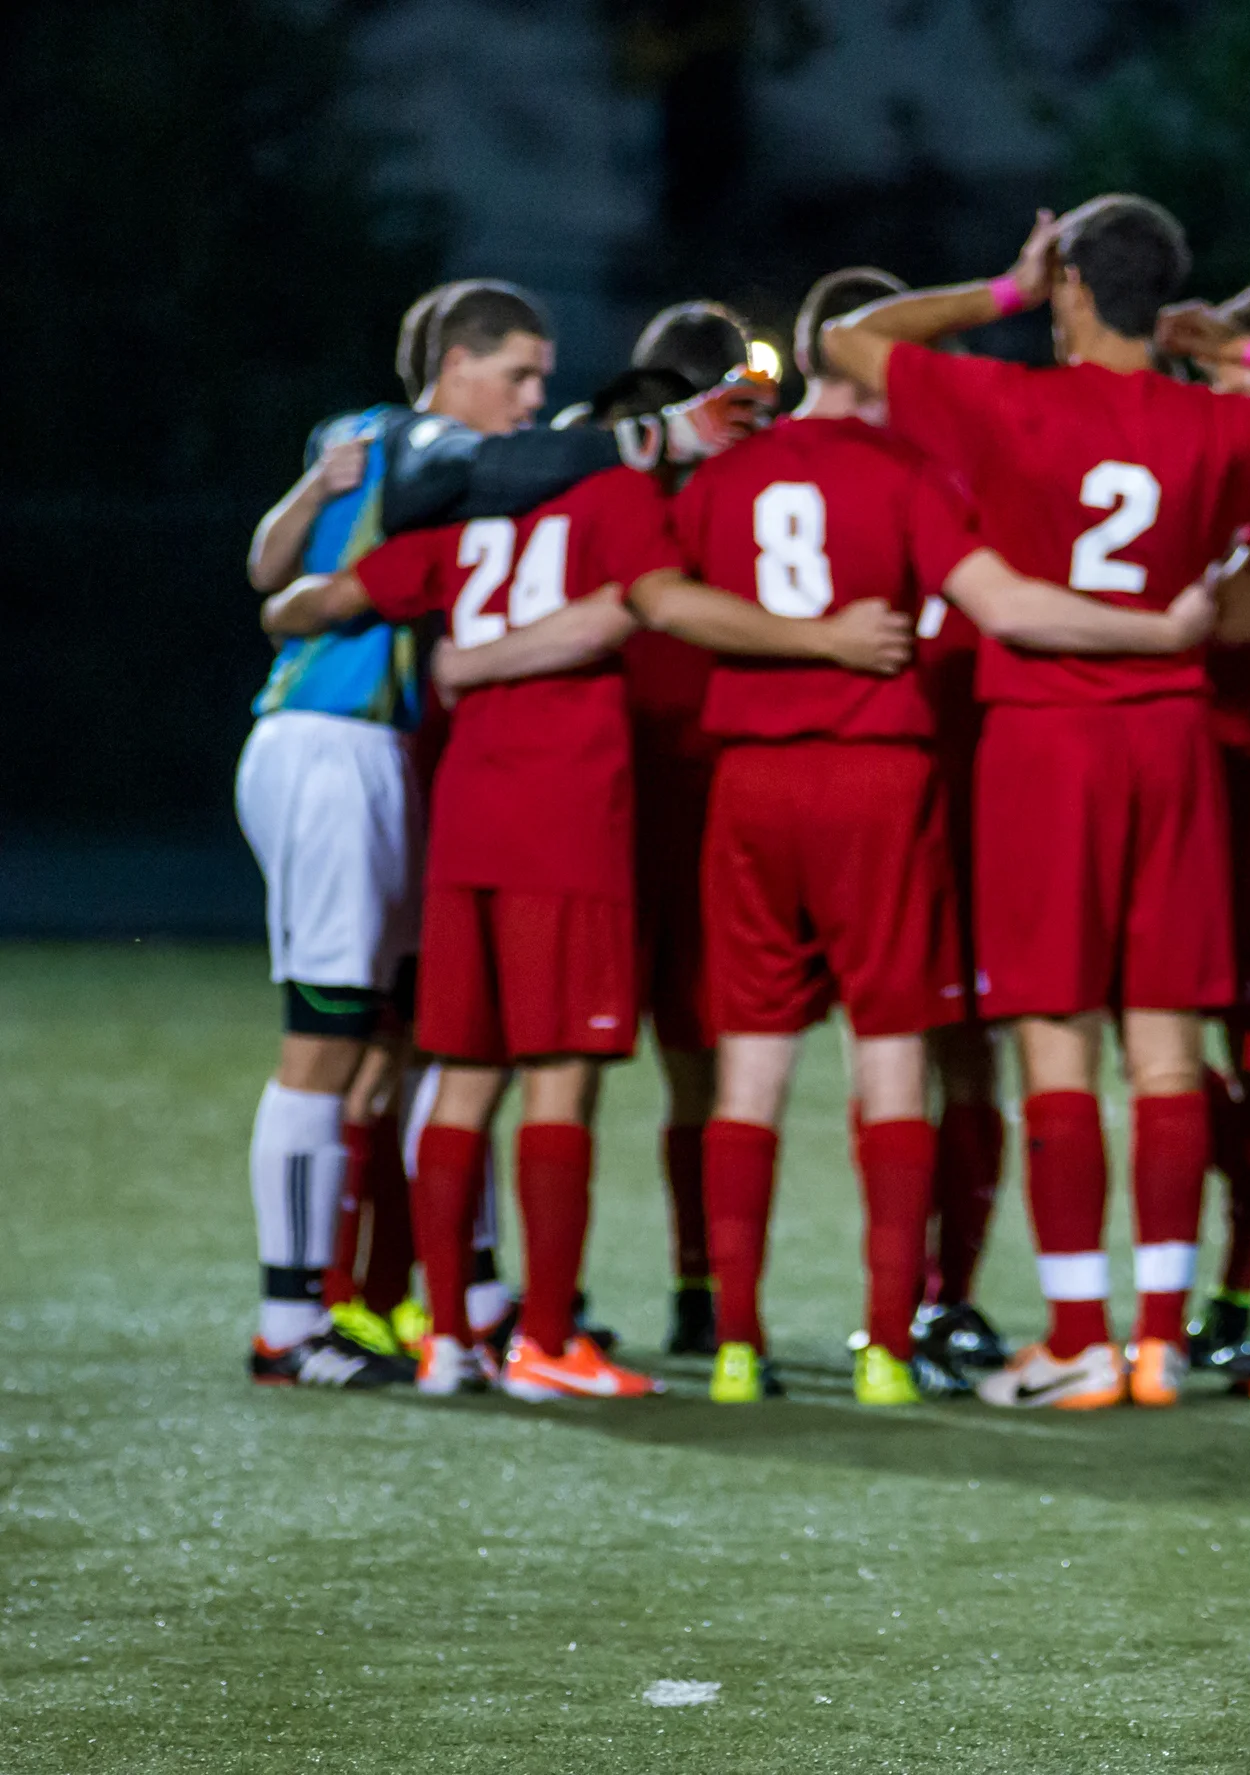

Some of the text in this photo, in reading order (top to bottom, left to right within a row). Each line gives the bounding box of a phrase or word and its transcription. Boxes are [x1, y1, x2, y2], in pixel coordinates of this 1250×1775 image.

[453, 515, 570, 649] 24
[754, 482, 833, 620] 8
[1069, 461, 1161, 593] 2
